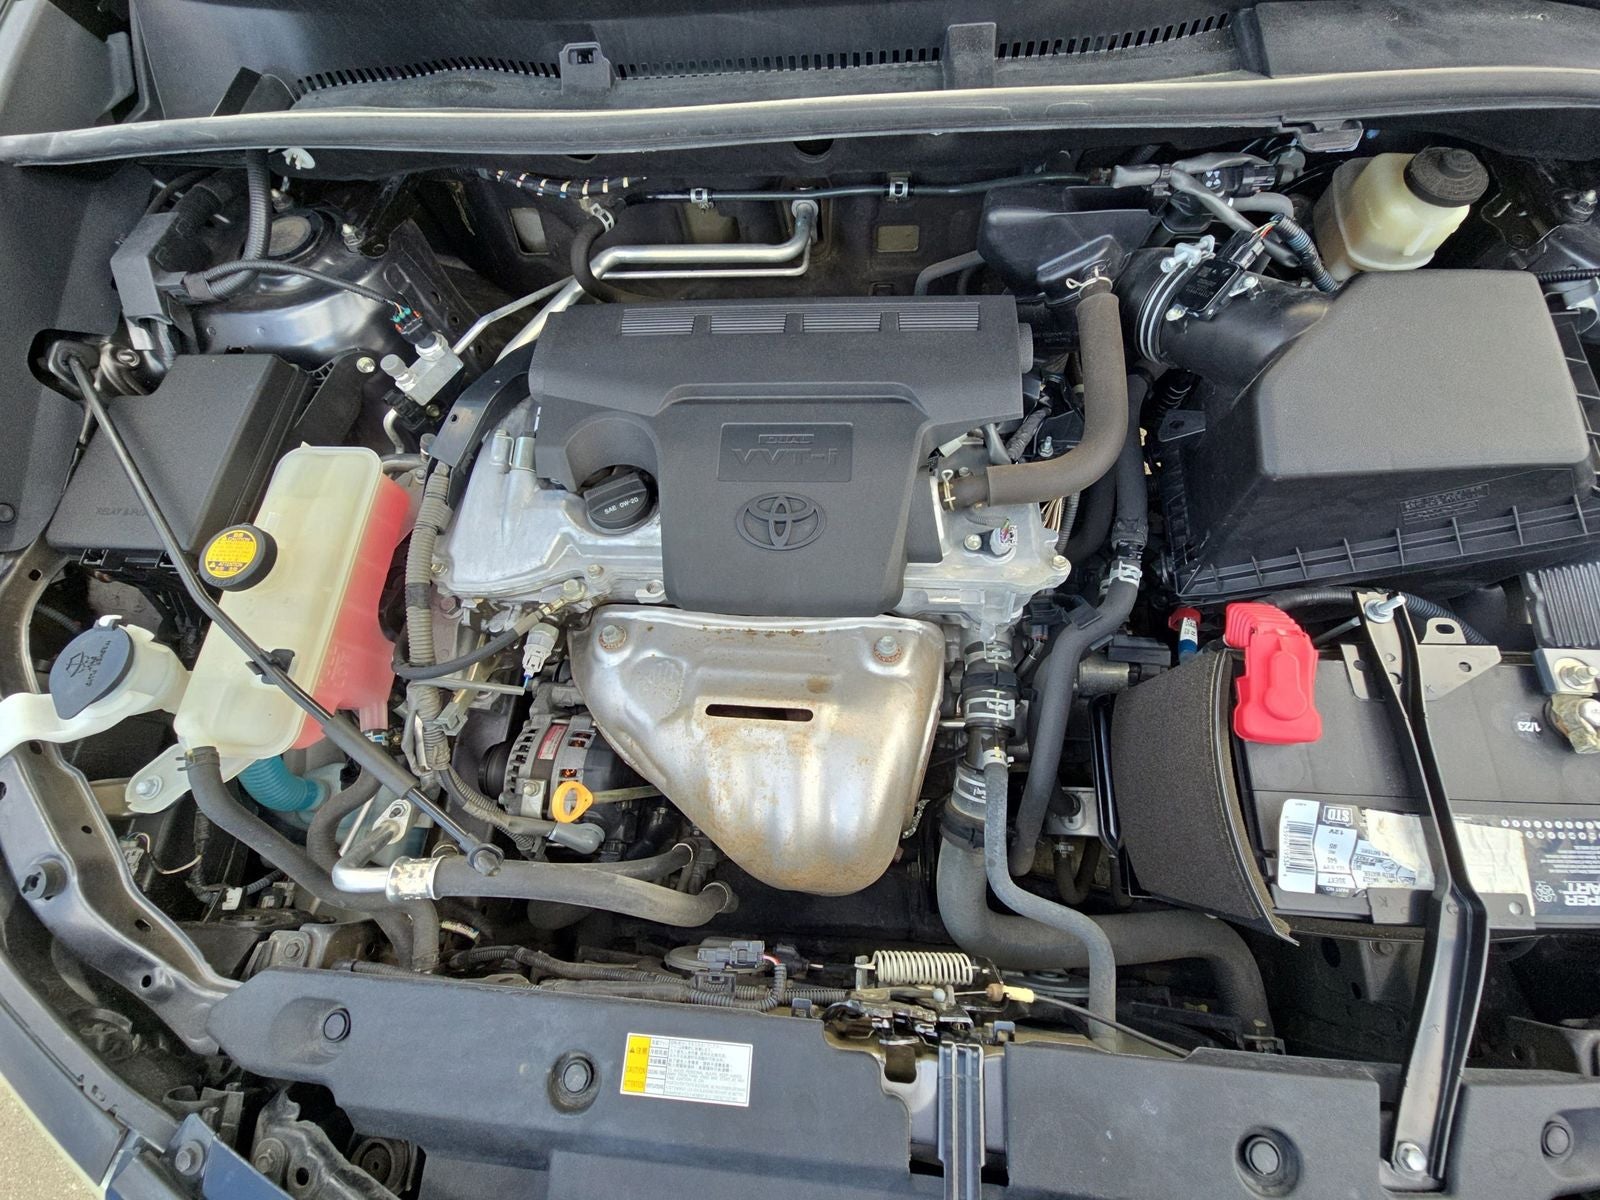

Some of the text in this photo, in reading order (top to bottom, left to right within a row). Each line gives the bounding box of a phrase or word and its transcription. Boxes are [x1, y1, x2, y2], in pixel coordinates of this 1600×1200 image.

[604, 496, 639, 515] SAE 0W-20
[1516, 722, 1541, 733] 1/23
[1327, 809, 1350, 823] STD
